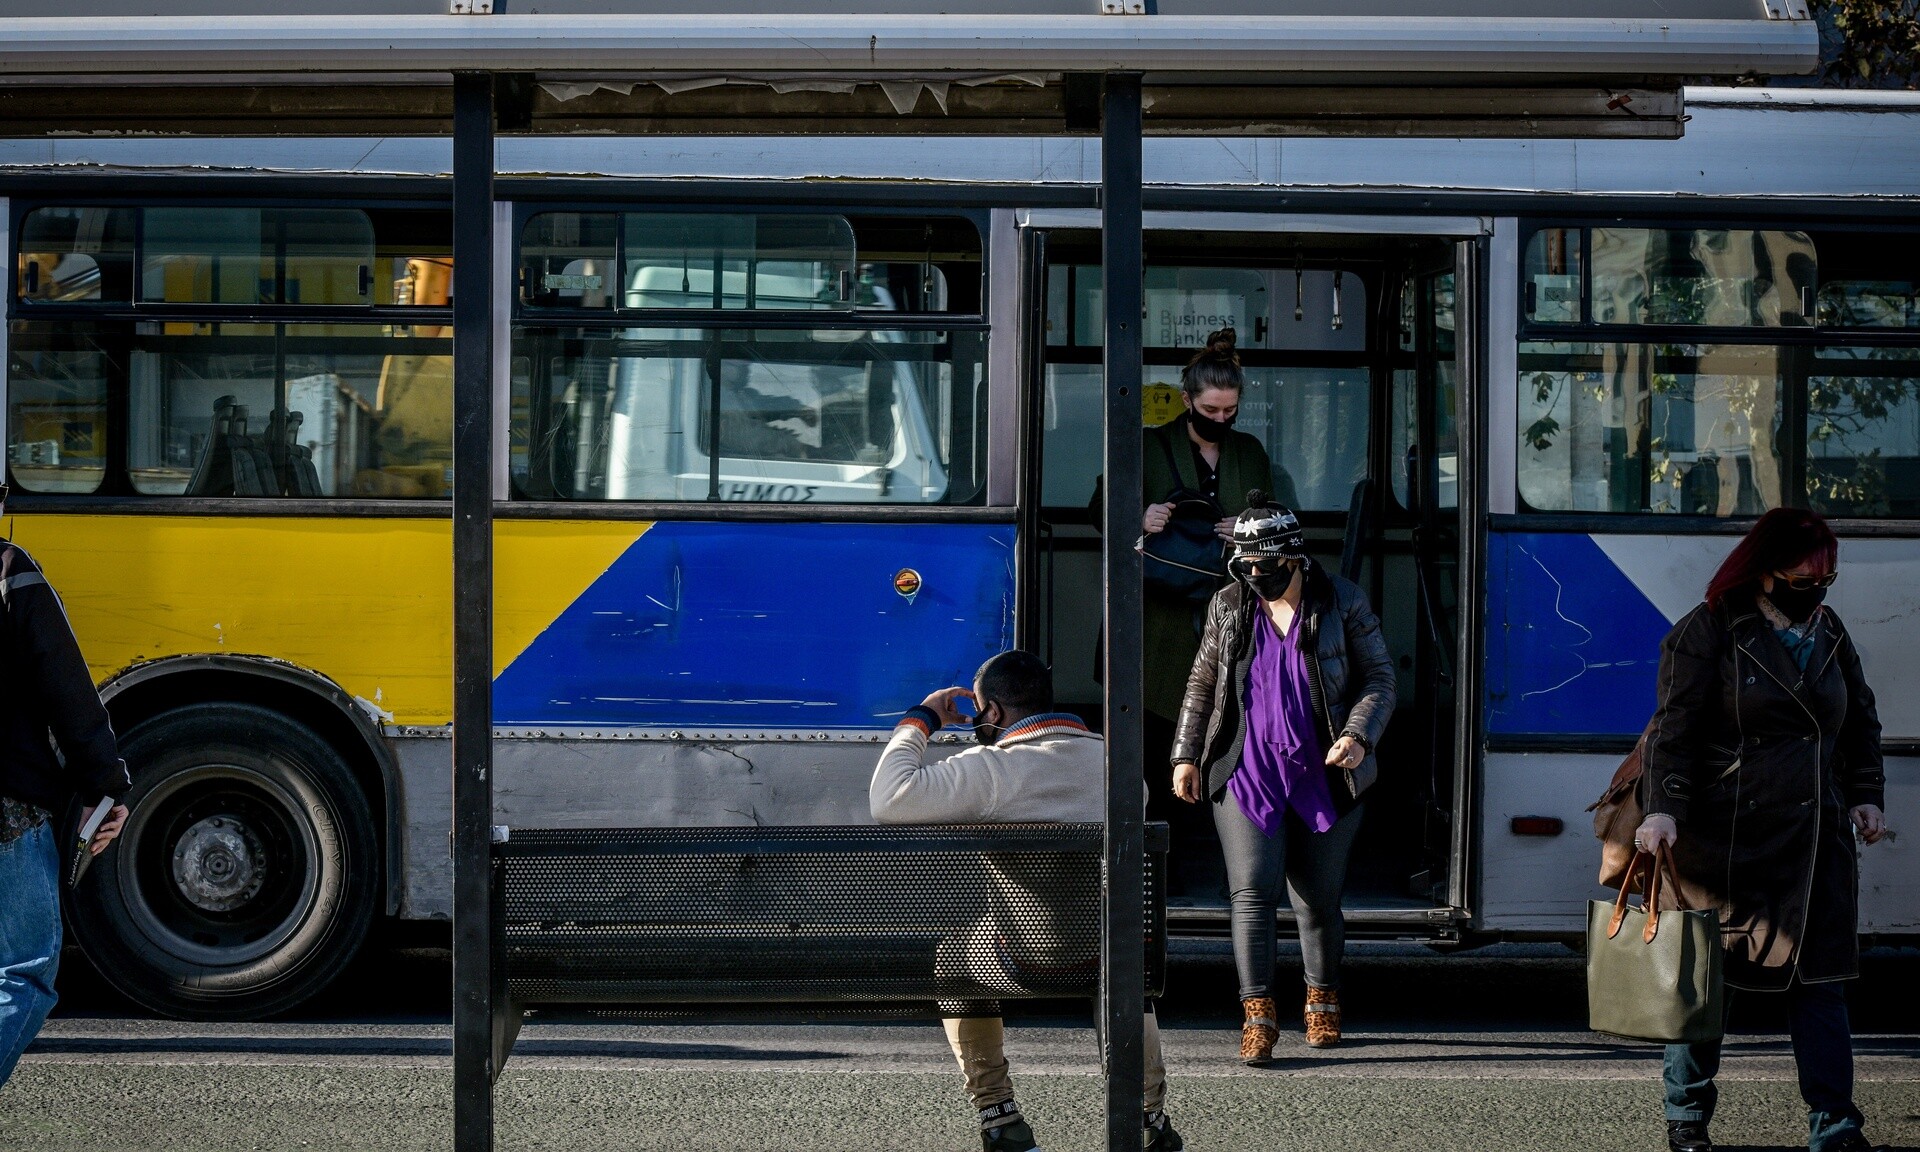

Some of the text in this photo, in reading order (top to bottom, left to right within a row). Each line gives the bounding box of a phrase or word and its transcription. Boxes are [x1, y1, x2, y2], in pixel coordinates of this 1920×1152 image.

[1160, 309, 1235, 326] Business
[1160, 329, 1210, 345] Bank
[312, 803, 341, 870] CITY
